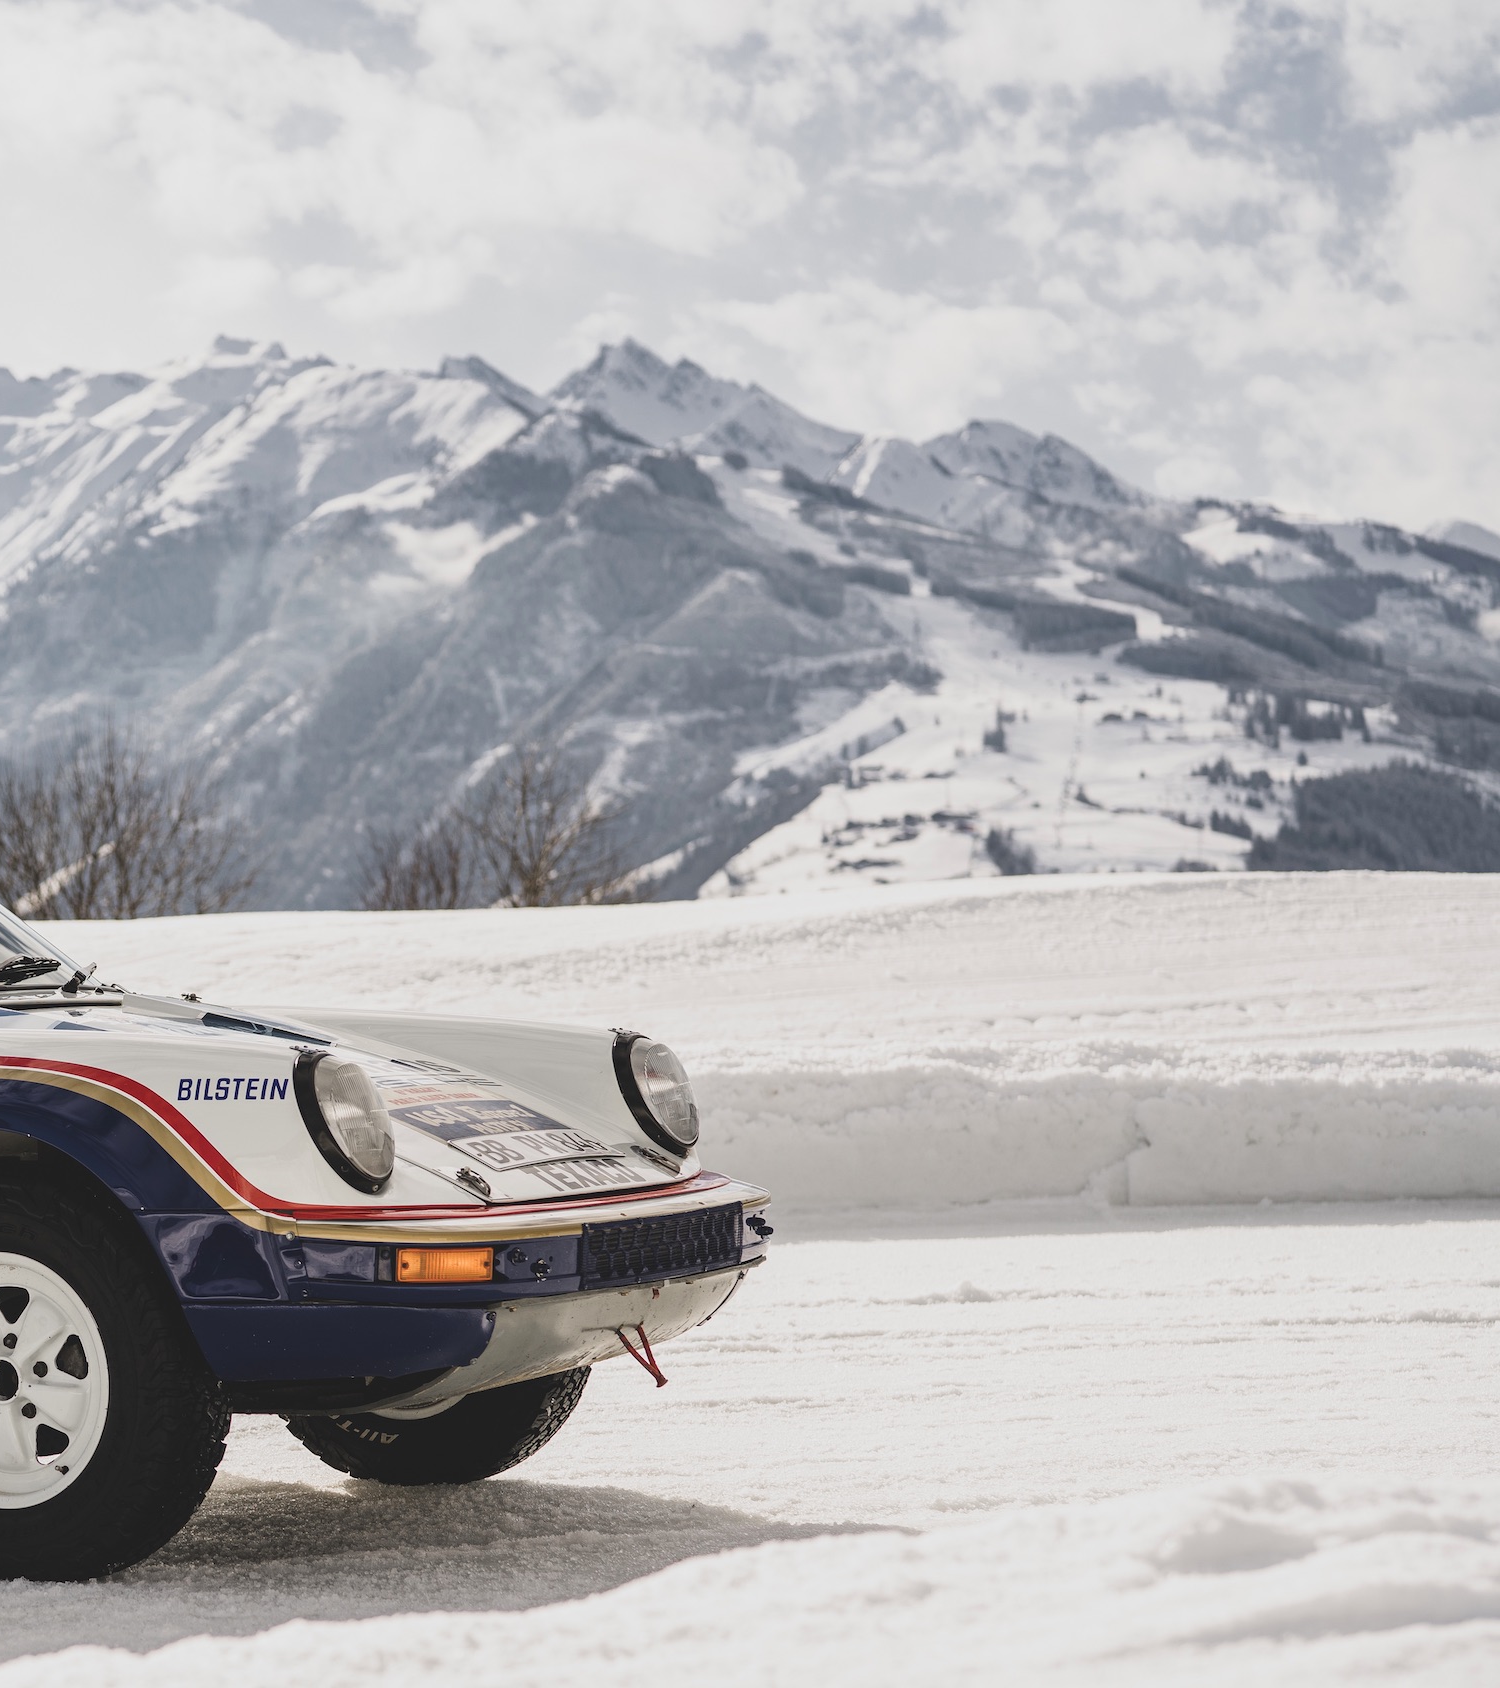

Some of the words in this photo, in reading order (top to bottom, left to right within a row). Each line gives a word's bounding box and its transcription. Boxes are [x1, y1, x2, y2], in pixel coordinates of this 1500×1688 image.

[177, 1077, 290, 1101] BILSTEIN
[466, 1139, 525, 1164] BB
[517, 1157, 647, 1192] TEXACO
[328, 1415, 400, 1444] All-T
